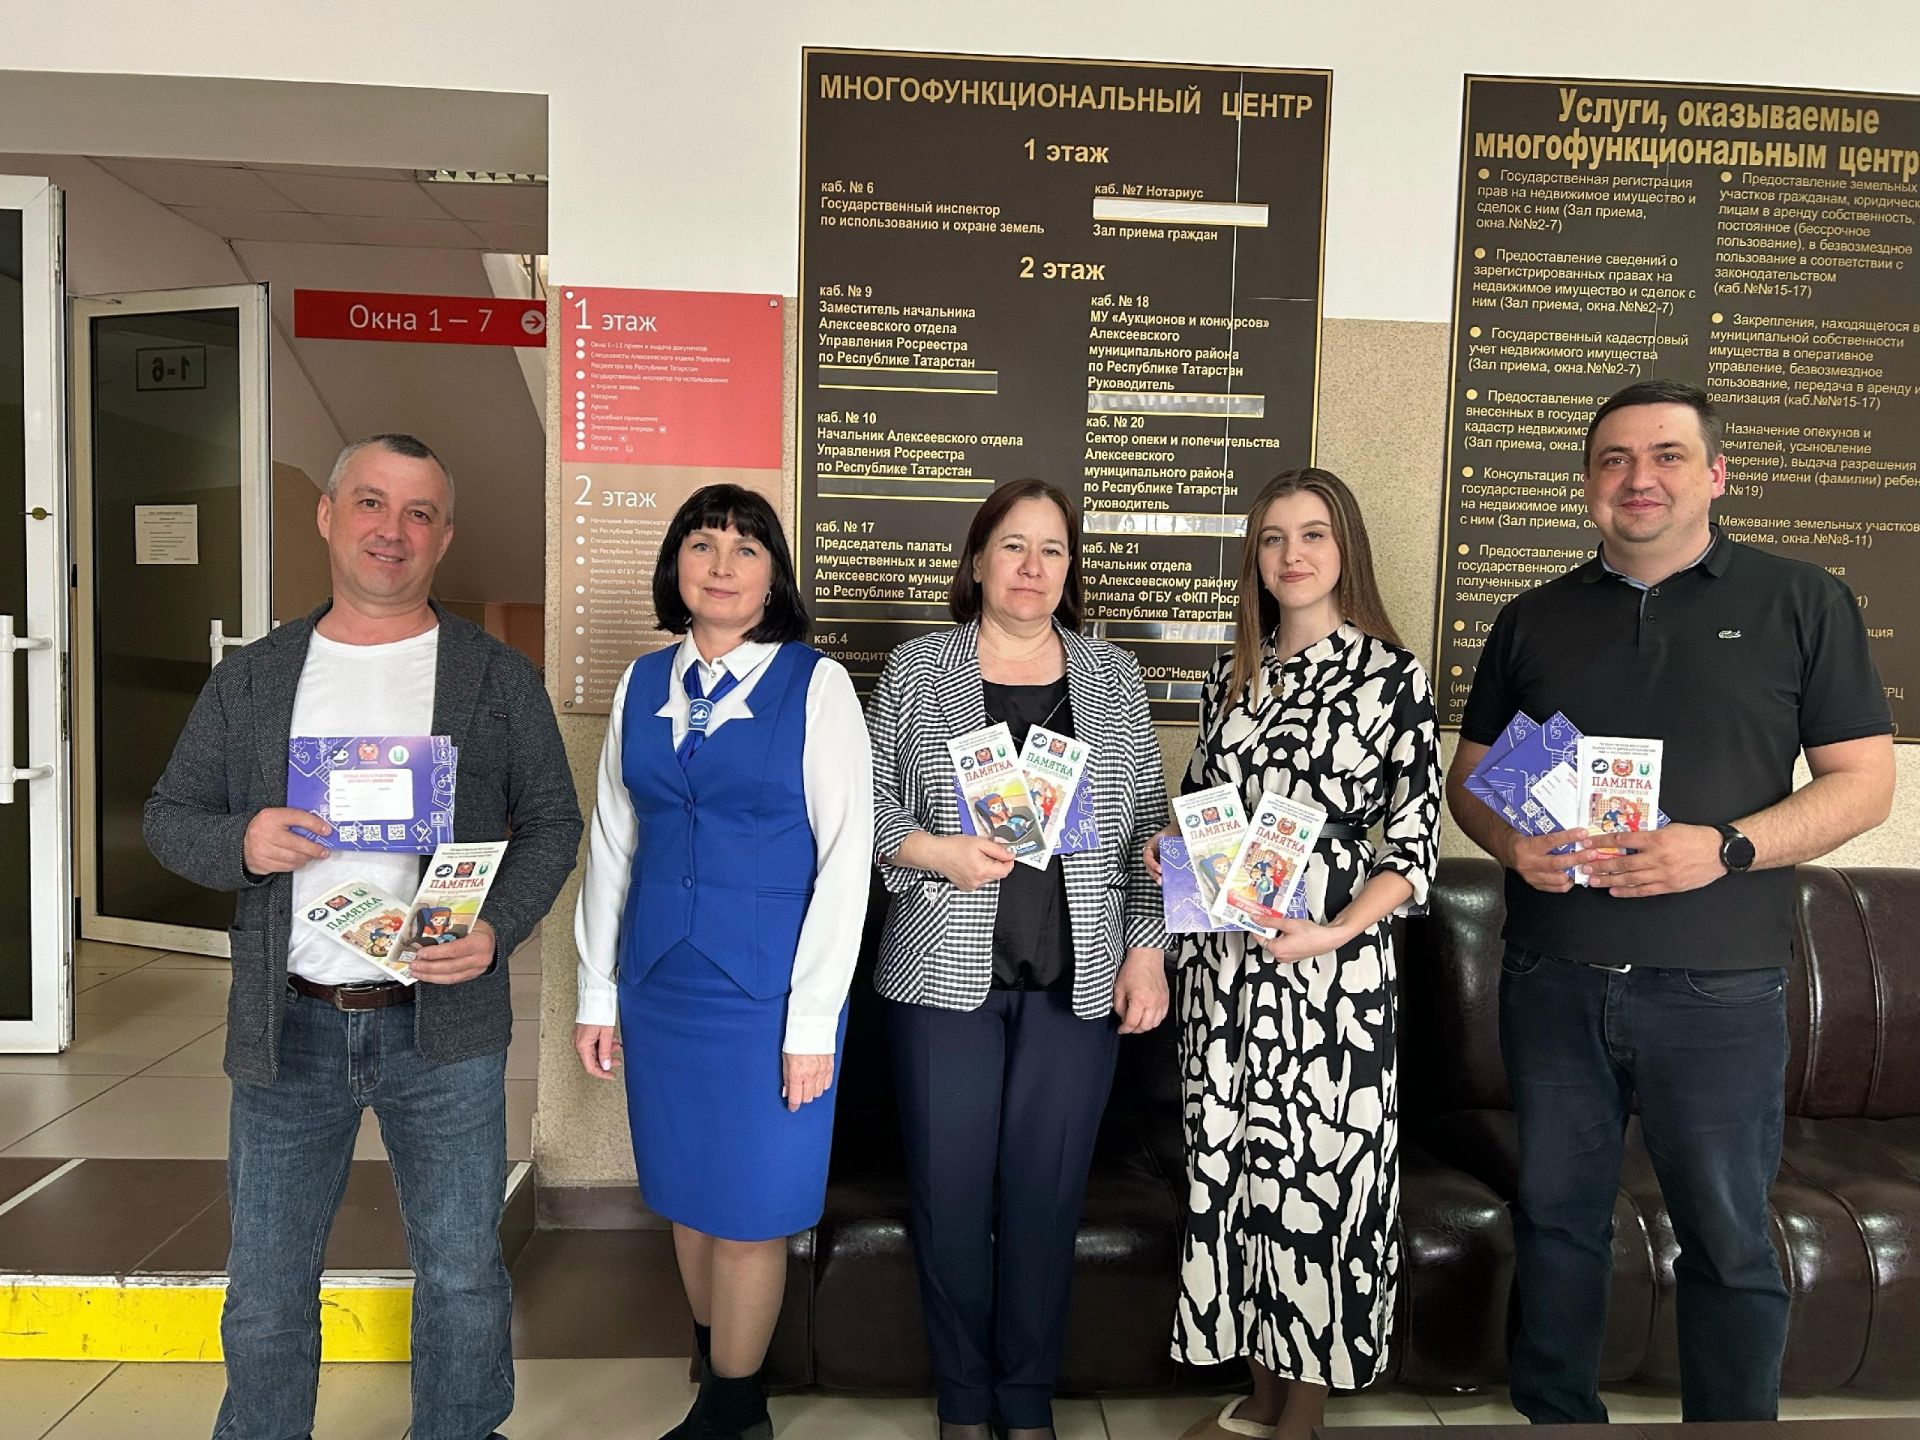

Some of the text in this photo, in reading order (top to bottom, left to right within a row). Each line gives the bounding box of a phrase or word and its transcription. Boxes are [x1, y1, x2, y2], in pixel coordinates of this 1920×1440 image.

[820, 75, 1313, 119] МНОГОФУНКЦИОНАЛЬНЫЙ ЦЕНТР
[1558, 87, 1880, 134] Услуги, оказываемые
[1023, 137, 1109, 163] 1 этаж
[1474, 128, 1920, 183] многофункциональным центр
[820, 179, 846, 193] каб.
[866, 181, 874, 194] 6
[1500, 168, 1693, 190] Государственная регистрация
[1741, 171, 1918, 193] Предоставление земельных
[1094, 182, 1119, 195] каб.
[1145, 184, 1204, 201] Нотариус
[1477, 186, 1696, 205] прав на недвижимое имущество и
[820, 195, 1000, 219] Государственный инспектор
[1476, 201, 1646, 220] сделок с ним (Зал приема,
[1717, 204, 1915, 225] лицам в аренду собственность,
[820, 215, 1045, 234] по использованию и охране земель
[1092, 222, 1218, 242] Зал приема граждан
[1716, 220, 1870, 238] постоянное (бессрочное
[1496, 247, 1678, 267] Предоставление сведений о
[1019, 255, 1105, 281] 2 этаж
[1473, 265, 1673, 283] зарегистрированных правах на
[1713, 267, 1837, 282] законодательством
[819, 283, 844, 297] каб.
[864, 285, 872, 298] 9
[818, 299, 976, 318] Заместитель начальника
[1090, 293, 1115, 307] каб.
[1135, 294, 1149, 308] 18
[349, 304, 417, 331] Окна
[428, 309, 442, 332] 1
[478, 309, 493, 332] 7
[574, 298, 657, 332] 1 этаж
[1090, 309, 1270, 331] МУ «Аукционов и конкурсов»
[1088, 326, 1180, 342] Алексеевского
[1491, 326, 1688, 349] Государственный кадастровый
[1710, 330, 1904, 347] муниципальной собственности
[818, 350, 975, 370] по Республике Татарстан
[1468, 344, 1658, 362] учет недвижимого имущества
[1708, 345, 1874, 362] имущества в оперативное
[1707, 361, 1883, 378] управление, безвозмездное
[1087, 376, 1176, 392] Руководитель
[817, 410, 842, 423] каб.
[862, 411, 877, 424] 10
[1085, 414, 1110, 428] каб.
[1129, 415, 1145, 428] 20
[1465, 406, 1534, 418] внесенных
[816, 426, 1023, 447] Начальник Алексеевского отдела
[1464, 422, 1515, 435] кадастр
[1724, 421, 1871, 440] Назначение опекунов и
[1085, 430, 1280, 452] Сектор опеки и попечительства
[1789, 442, 1872, 454] усыновление
[816, 442, 965, 463] Управления Росреестра
[1790, 457, 1917, 472] выдача разрешения
[1483, 466, 1569, 483] Консультация
[574, 474, 657, 508] 2 этаж
[1082, 496, 1170, 511] Руководитель
[815, 519, 840, 533] каб.
[860, 521, 875, 533] 17
[1718, 514, 1791, 528] Межевание
[1793, 519, 1862, 530] земельных
[1081, 541, 1106, 554] каб.
[1125, 541, 1139, 554] 21
[1081, 556, 1192, 573] Начальник отдела
[813, 632, 848, 644] каб.4
[964, 759, 1013, 782] ПАМЯТКА
[1026, 752, 1073, 777] ПАМЯТКА
[1592, 776, 1653, 790] ПАМЯТКА
[1190, 819, 1241, 840] ПАМЯТКА
[1256, 826, 1306, 854] ПАМЯТКА
[429, 878, 485, 889] ПАМЯТКА
[326, 896, 383, 931] ПАМЯТКА
